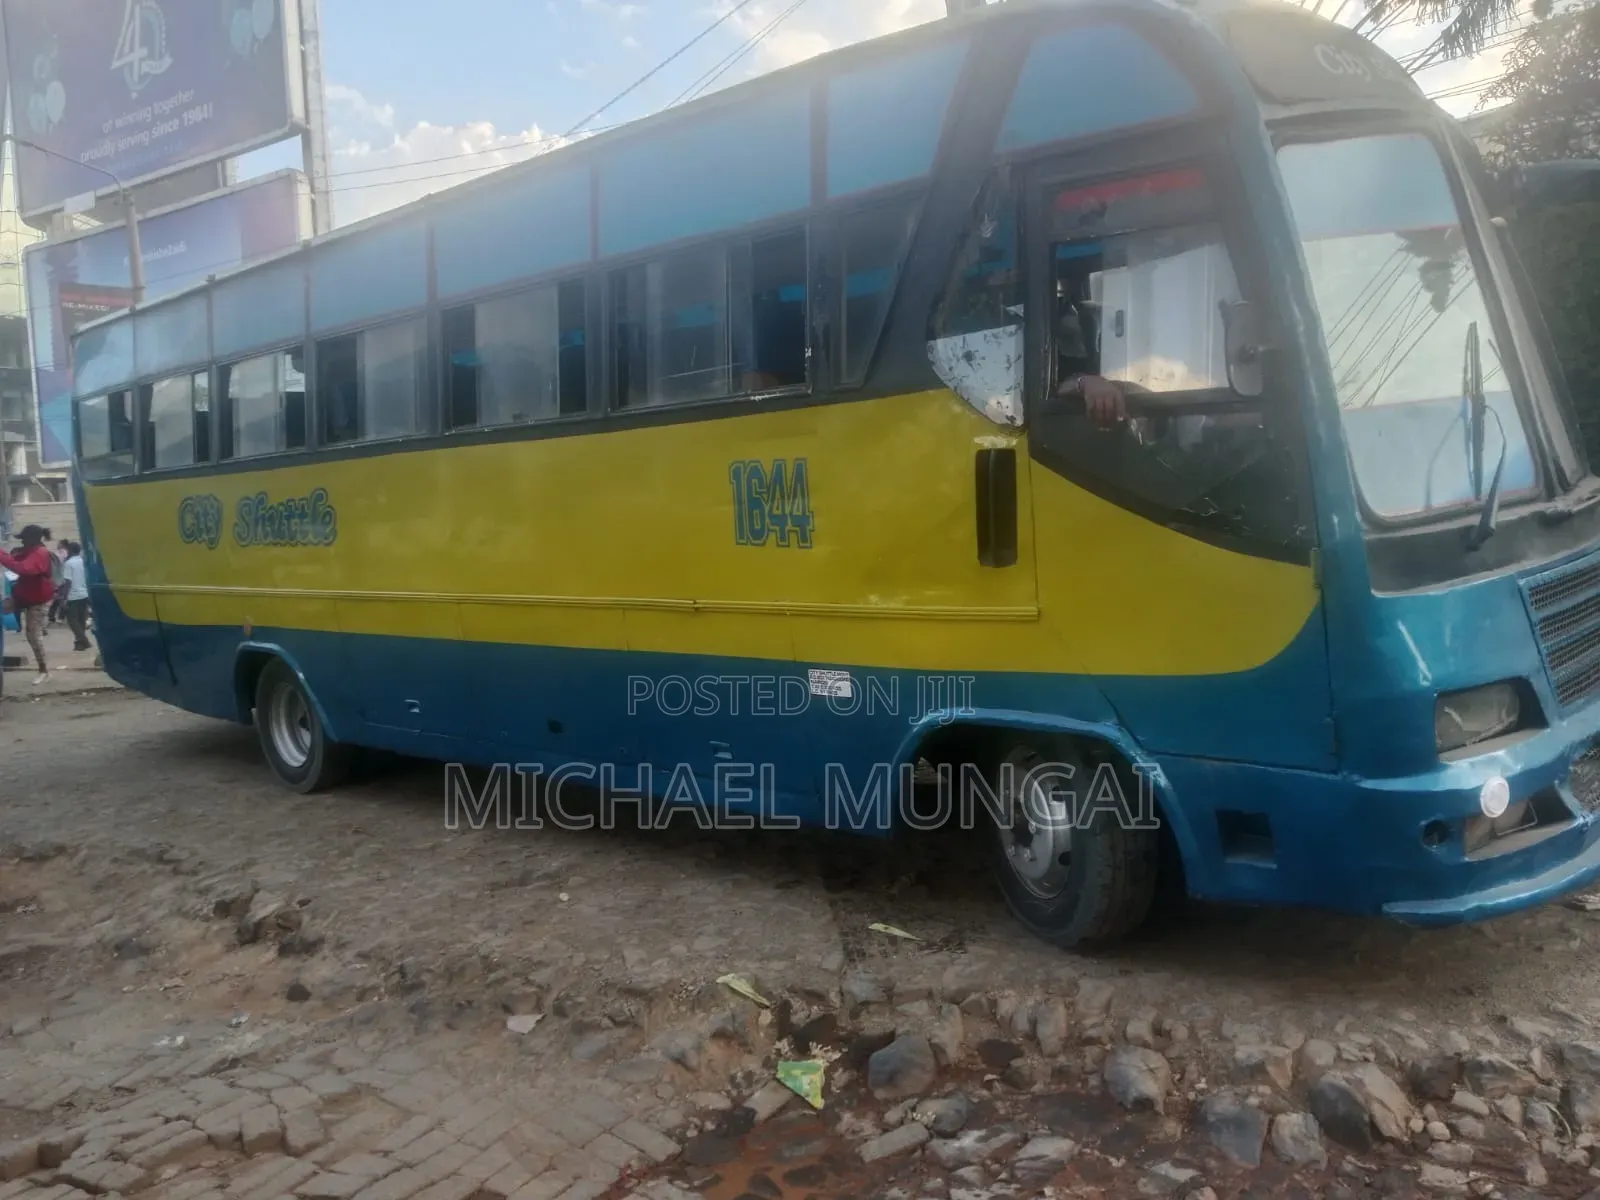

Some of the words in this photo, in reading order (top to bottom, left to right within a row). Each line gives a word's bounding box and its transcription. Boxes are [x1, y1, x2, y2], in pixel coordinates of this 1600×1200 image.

[114, 105, 152, 130] winning
[153, 88, 195, 115] together
[80, 138, 116, 164] proudly
[117, 128, 150, 152] serving
[151, 116, 180, 139] since
[178, 494, 223, 550] City
[233, 487, 337, 547] Shuttle
[729, 458, 815, 549] 1644
